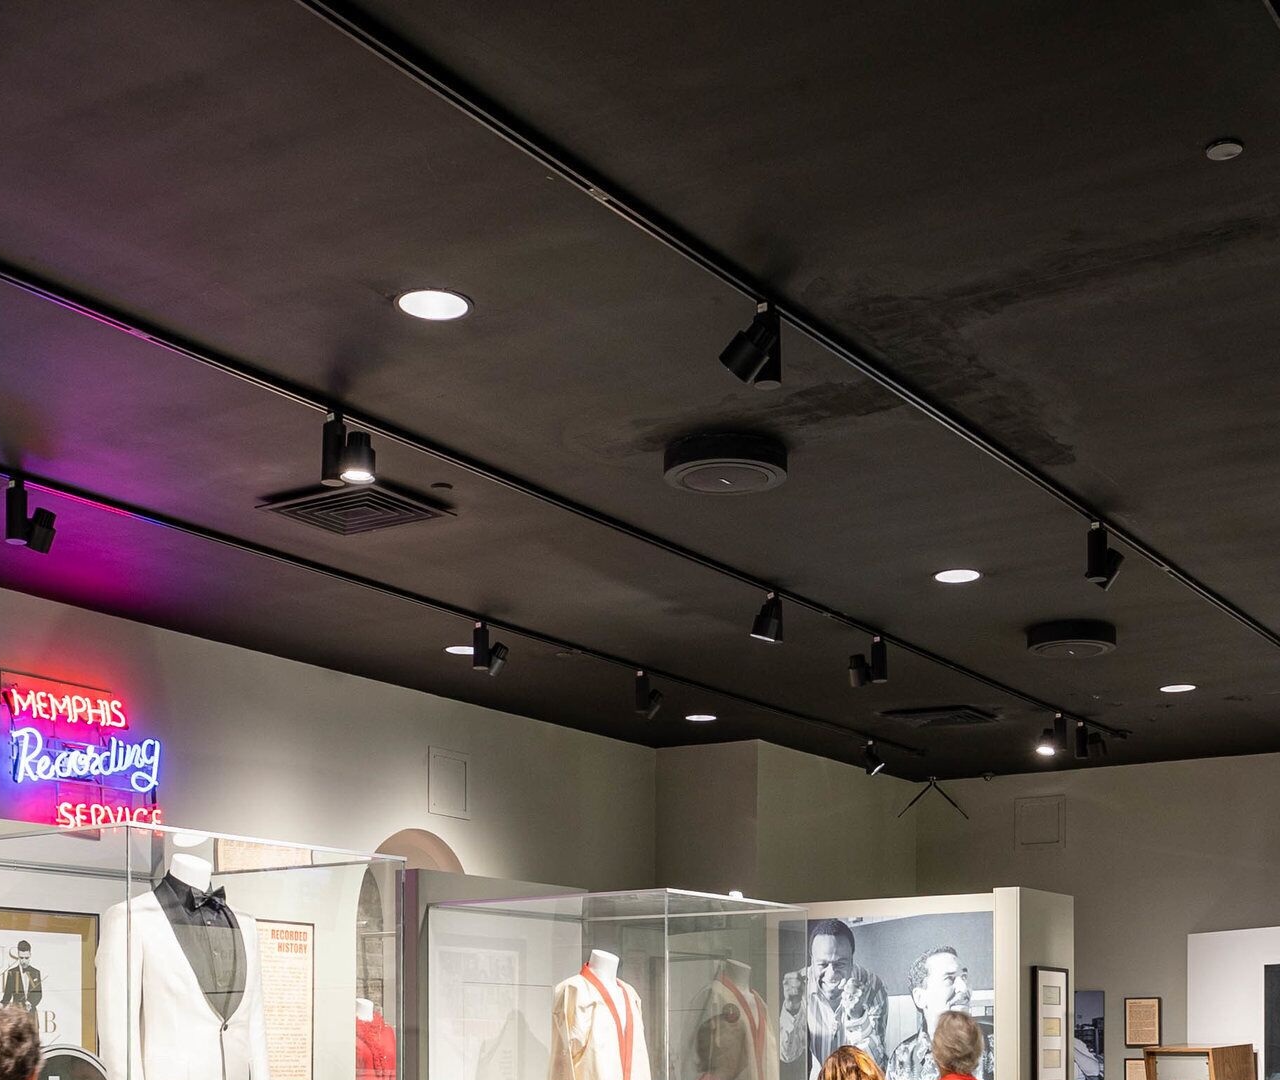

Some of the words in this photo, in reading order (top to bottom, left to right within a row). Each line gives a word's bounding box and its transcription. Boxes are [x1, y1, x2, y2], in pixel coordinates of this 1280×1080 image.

[11, 688, 127, 727] MEMPHIS
[10, 726, 161, 792] Recording
[58, 801, 162, 828] SERVICE
[271, 929, 308, 942] RECORDED
[277, 942, 308, 955] HISTORY
